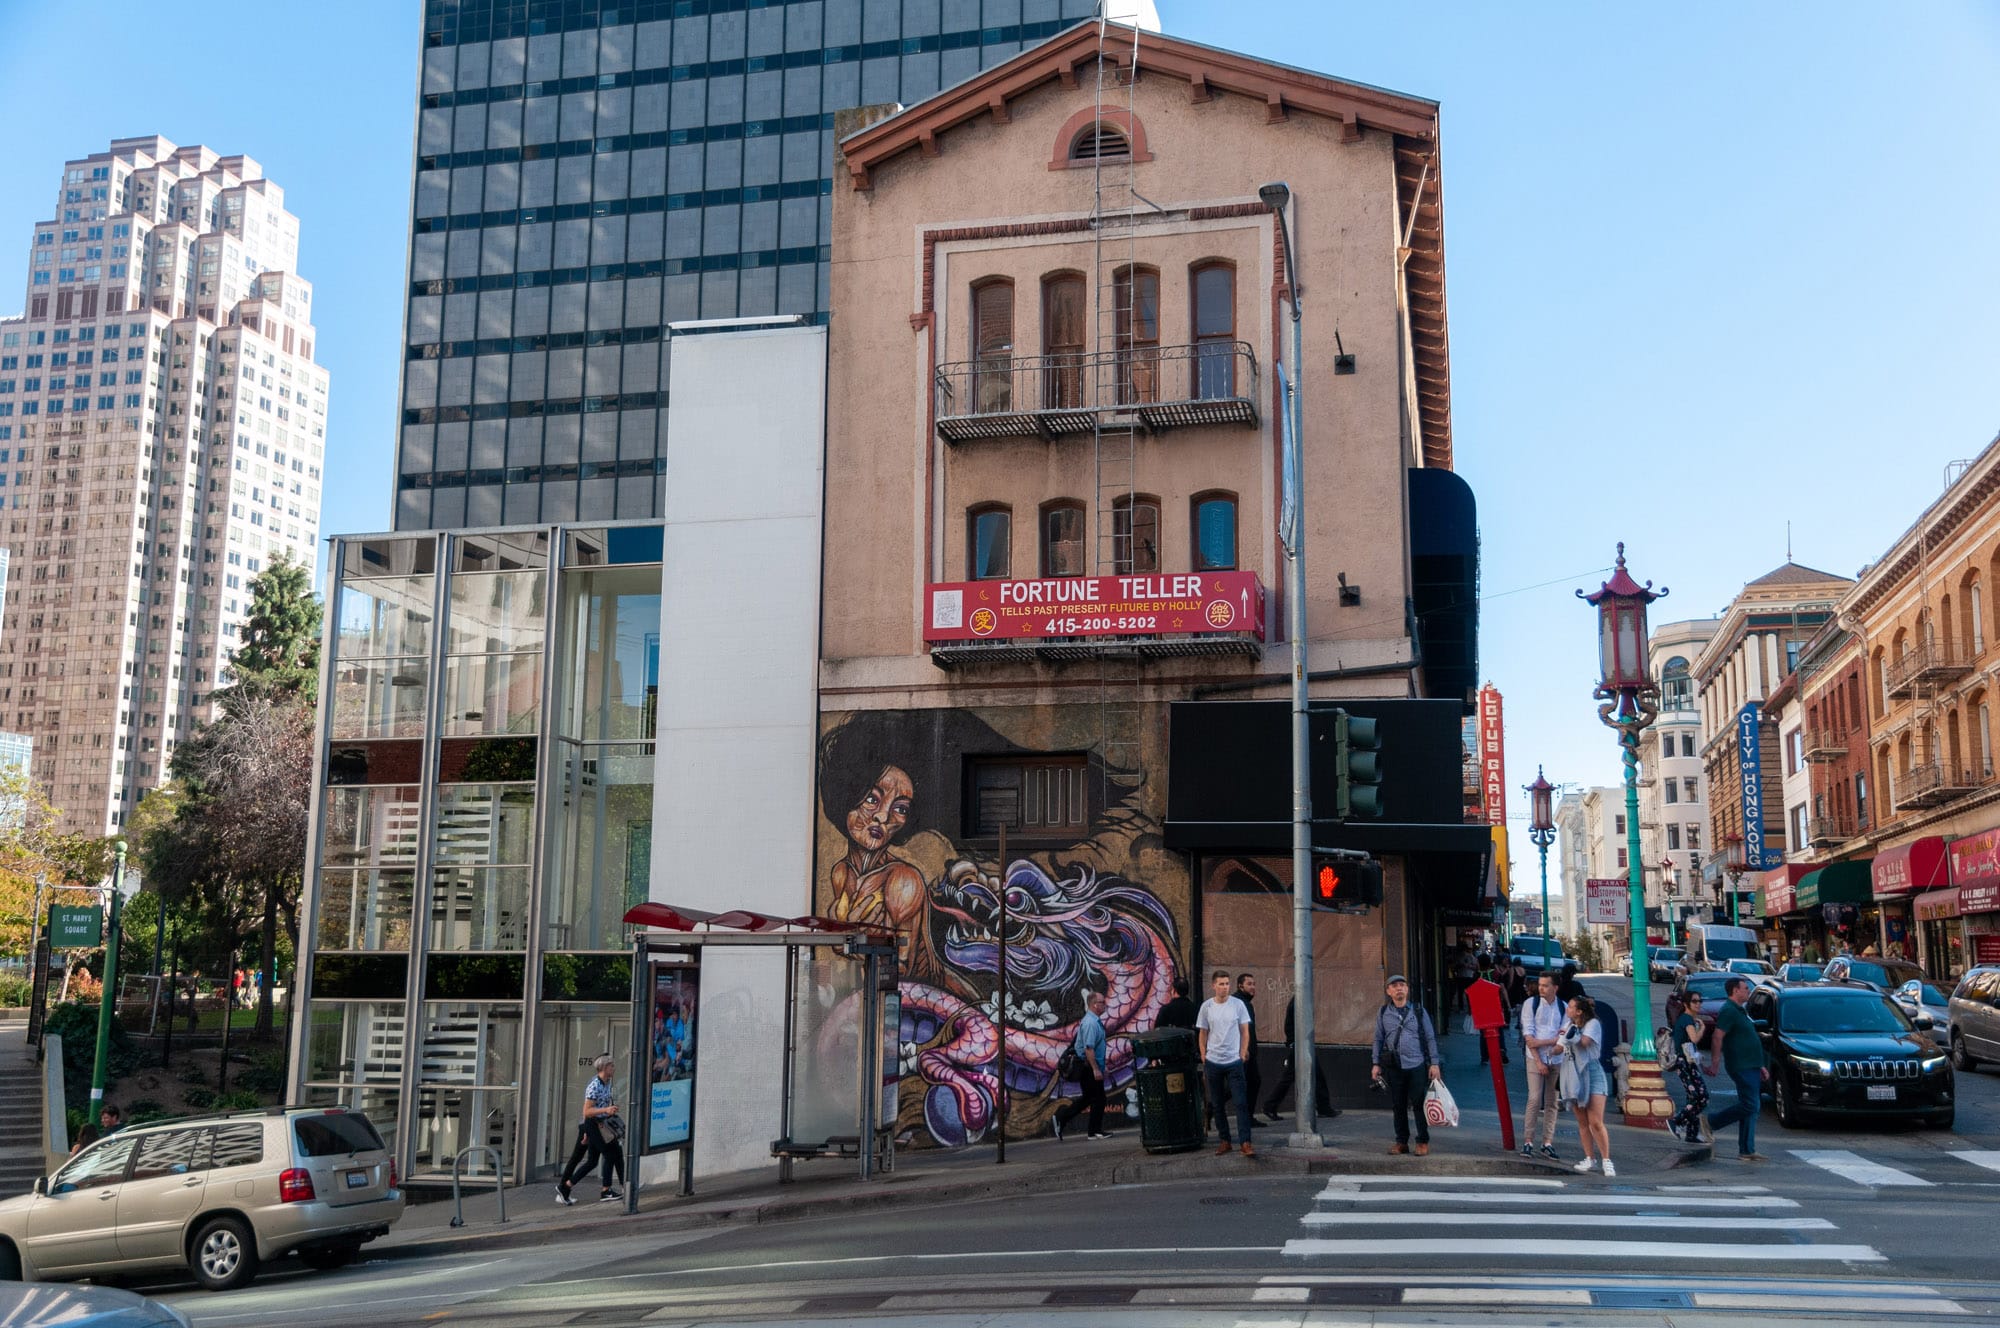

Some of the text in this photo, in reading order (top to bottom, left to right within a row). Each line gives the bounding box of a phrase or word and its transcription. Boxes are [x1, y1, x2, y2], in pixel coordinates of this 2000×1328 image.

[1000, 576, 1203, 604] FORTUNE TELLER
[1000, 600, 1203, 617] TELLS PAST PRESENT FUTURE BY HOLLY
[1209, 603, 1231, 624] 樂
[974, 610, 993, 632] 愛
[1045, 616, 1156, 634] 415-200-5202
[1485, 692, 1499, 754] LOTUS
[1740, 712, 1755, 759] CITY
[1742, 761, 1756, 770] OF
[1744, 774, 1758, 818] HONG
[1746, 820, 1762, 867] KONG
[1587, 887, 1626, 897] NO STOPPING
[1599, 907, 1617, 916] TIME
[1600, 899, 1615, 907] ANY
[578, 1057, 593, 1067] 675
